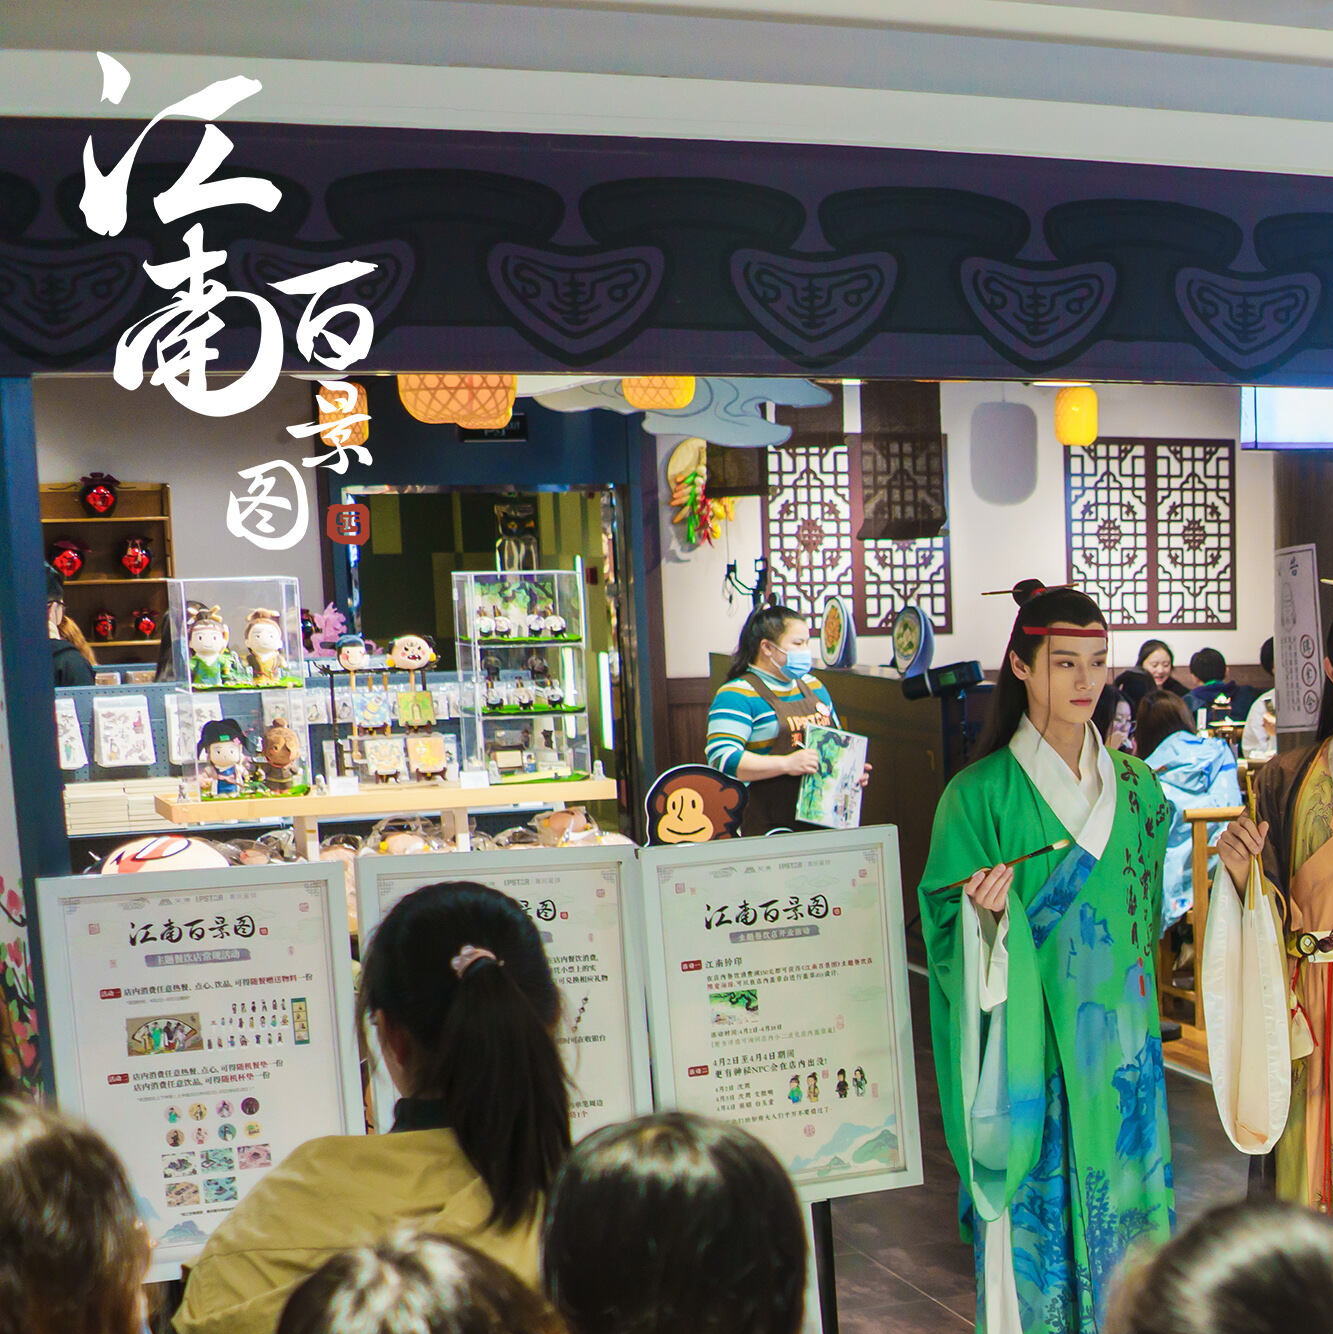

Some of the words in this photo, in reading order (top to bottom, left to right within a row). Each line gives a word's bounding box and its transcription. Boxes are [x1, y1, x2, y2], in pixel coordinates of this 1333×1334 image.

[704, 894, 829, 929] 江南百景图
[129, 915, 256, 946] 江南百景图
